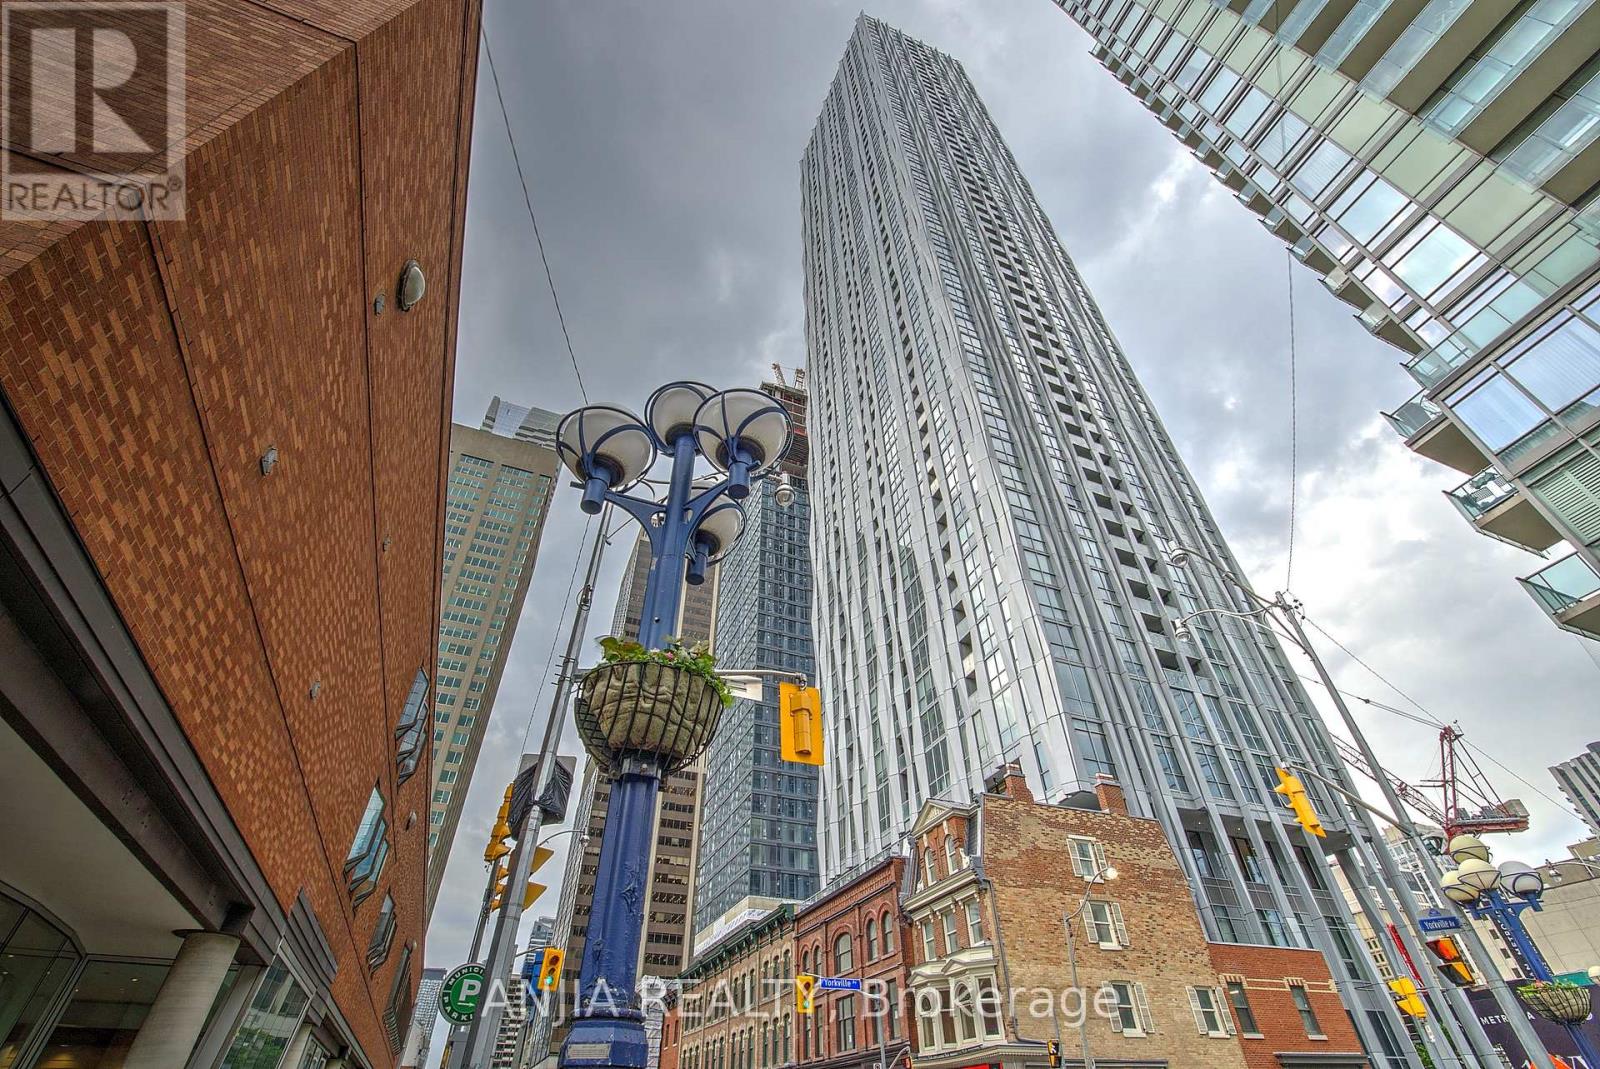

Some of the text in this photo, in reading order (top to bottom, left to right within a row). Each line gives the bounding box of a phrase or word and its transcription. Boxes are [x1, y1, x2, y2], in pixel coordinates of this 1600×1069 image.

[1424, 920, 1449, 929] Yorkville
[448, 967, 485, 986] MUNICI
[825, 979, 851, 987] Yorkville
[459, 979, 482, 1002] P
[443, 996, 474, 1021] PARKI
